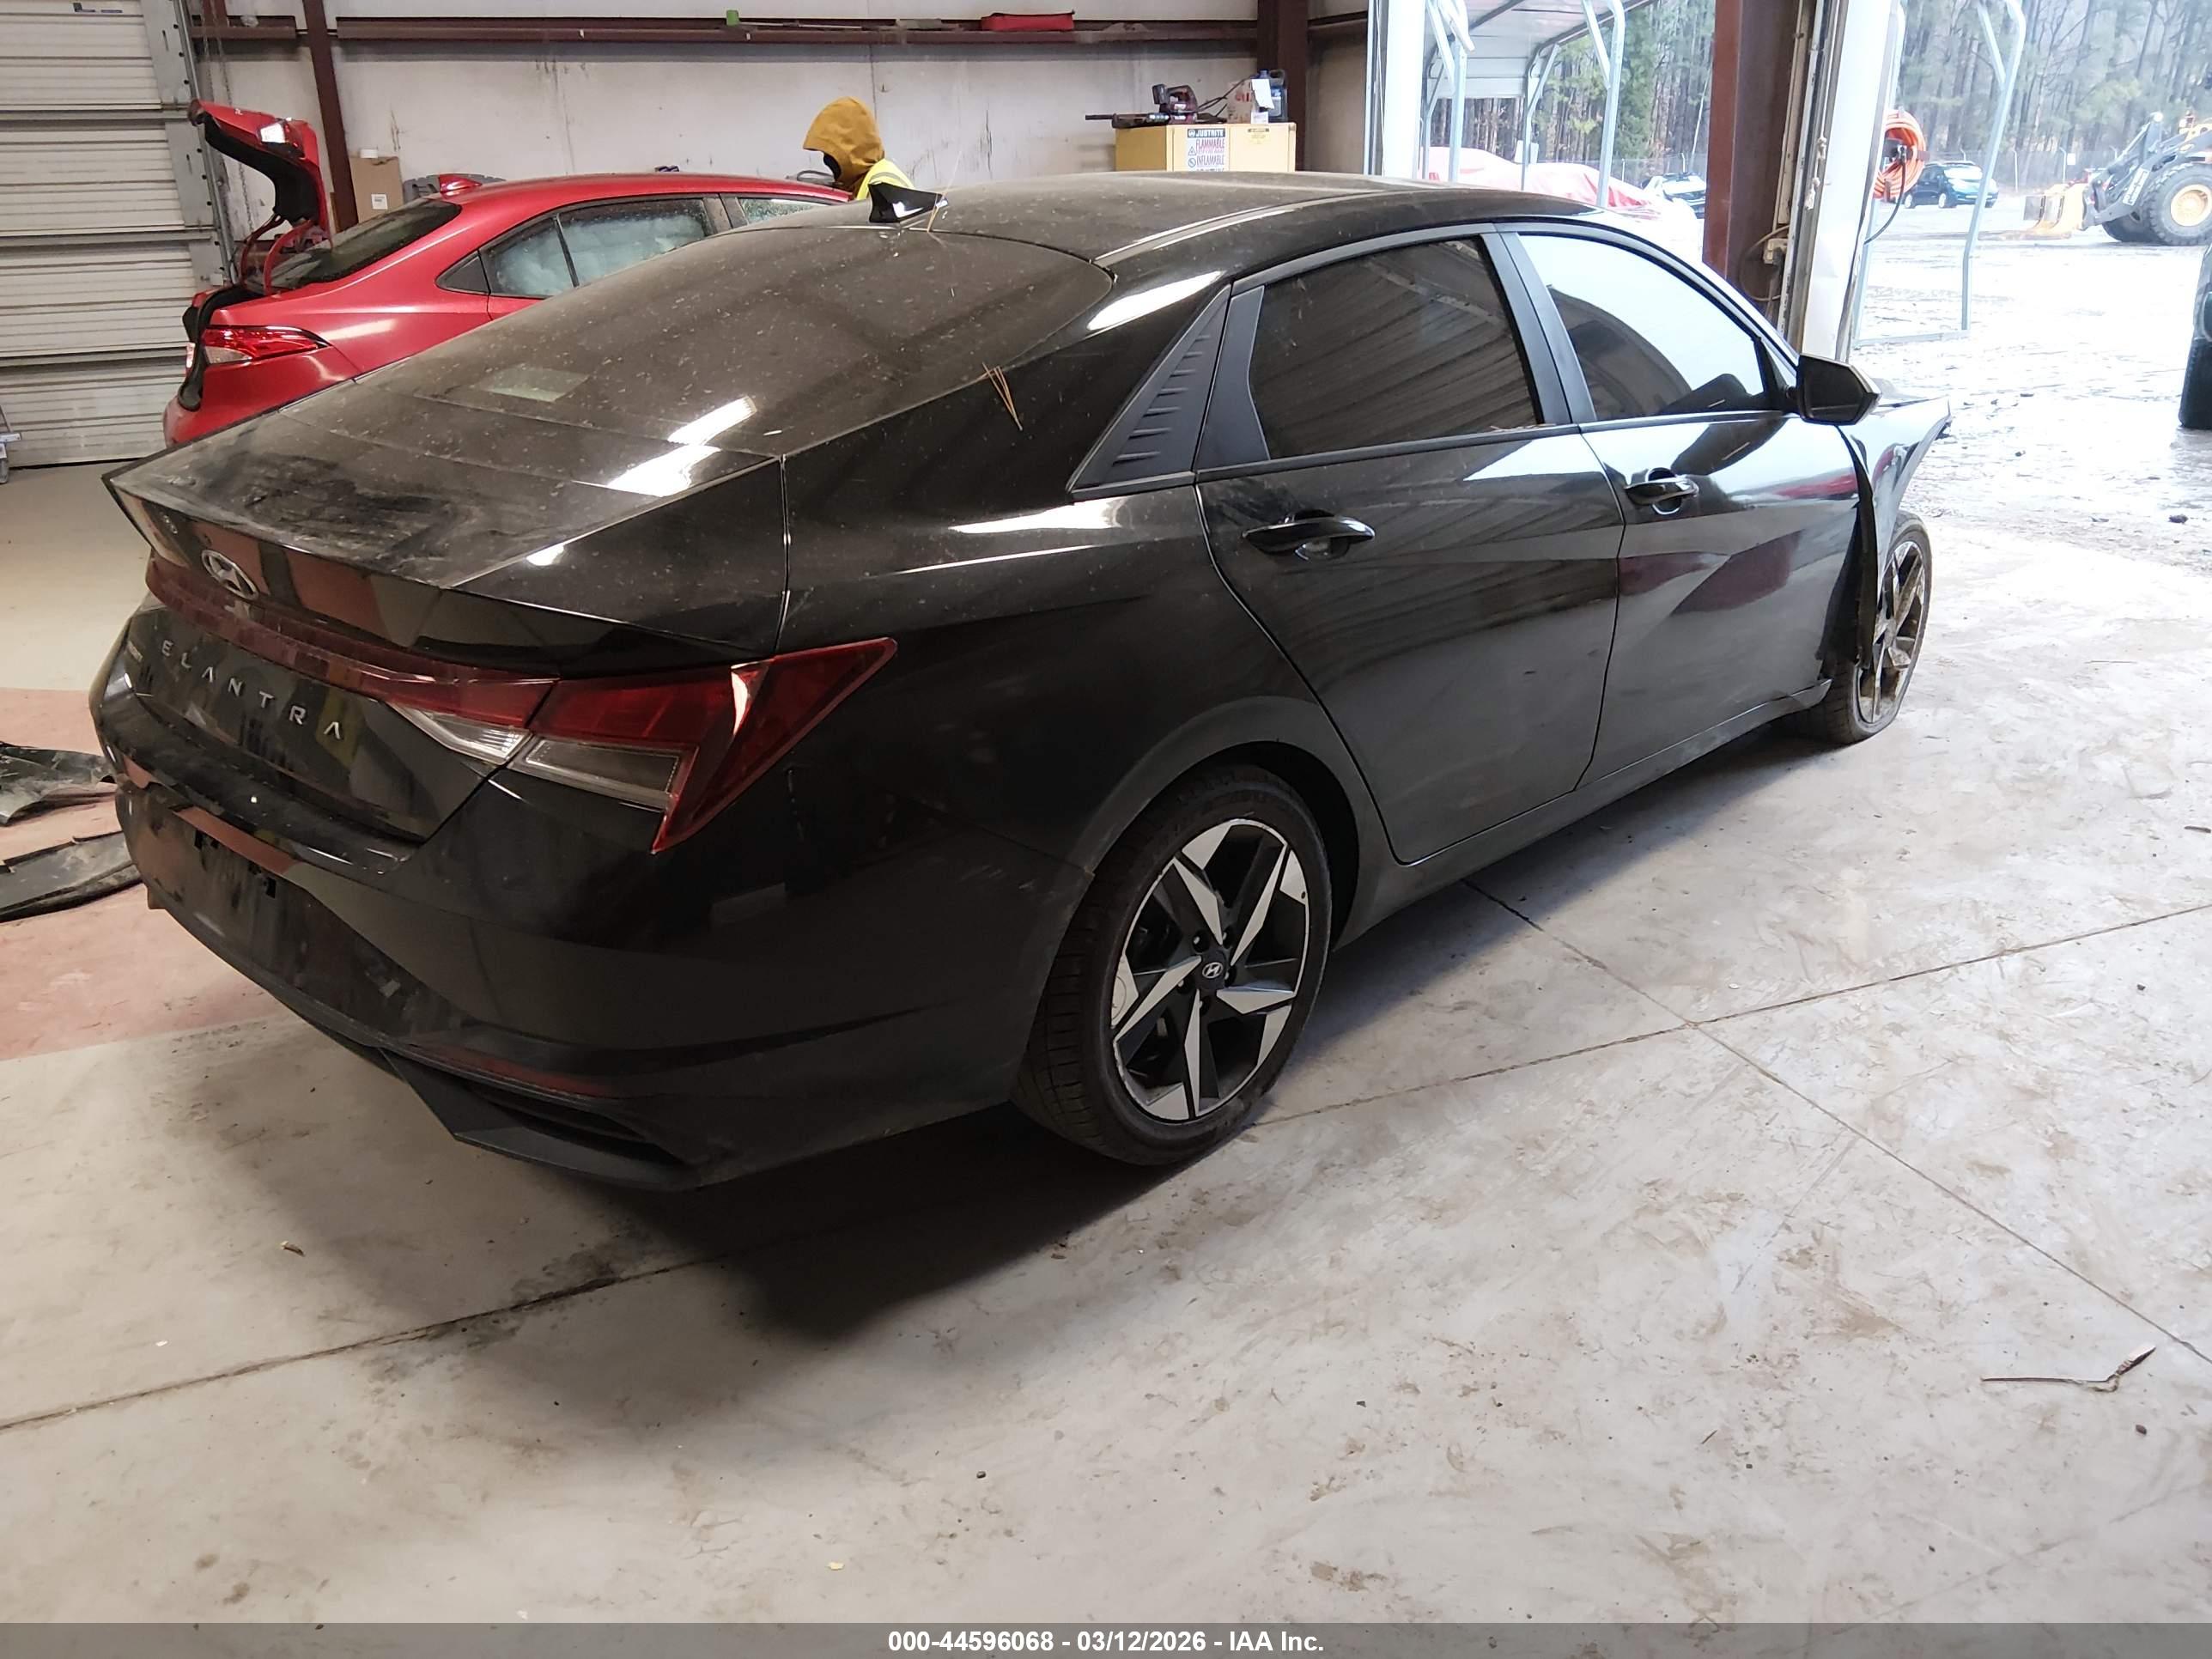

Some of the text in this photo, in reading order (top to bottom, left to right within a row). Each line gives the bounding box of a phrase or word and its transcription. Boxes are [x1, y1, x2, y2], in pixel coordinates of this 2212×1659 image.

[1195, 129, 1224, 137] JUSTRITE
[1196, 138, 1224, 149] FLAMMABLE
[1197, 155, 1224, 165] INFLAMABLE
[161, 639, 342, 740] ELANTRA
